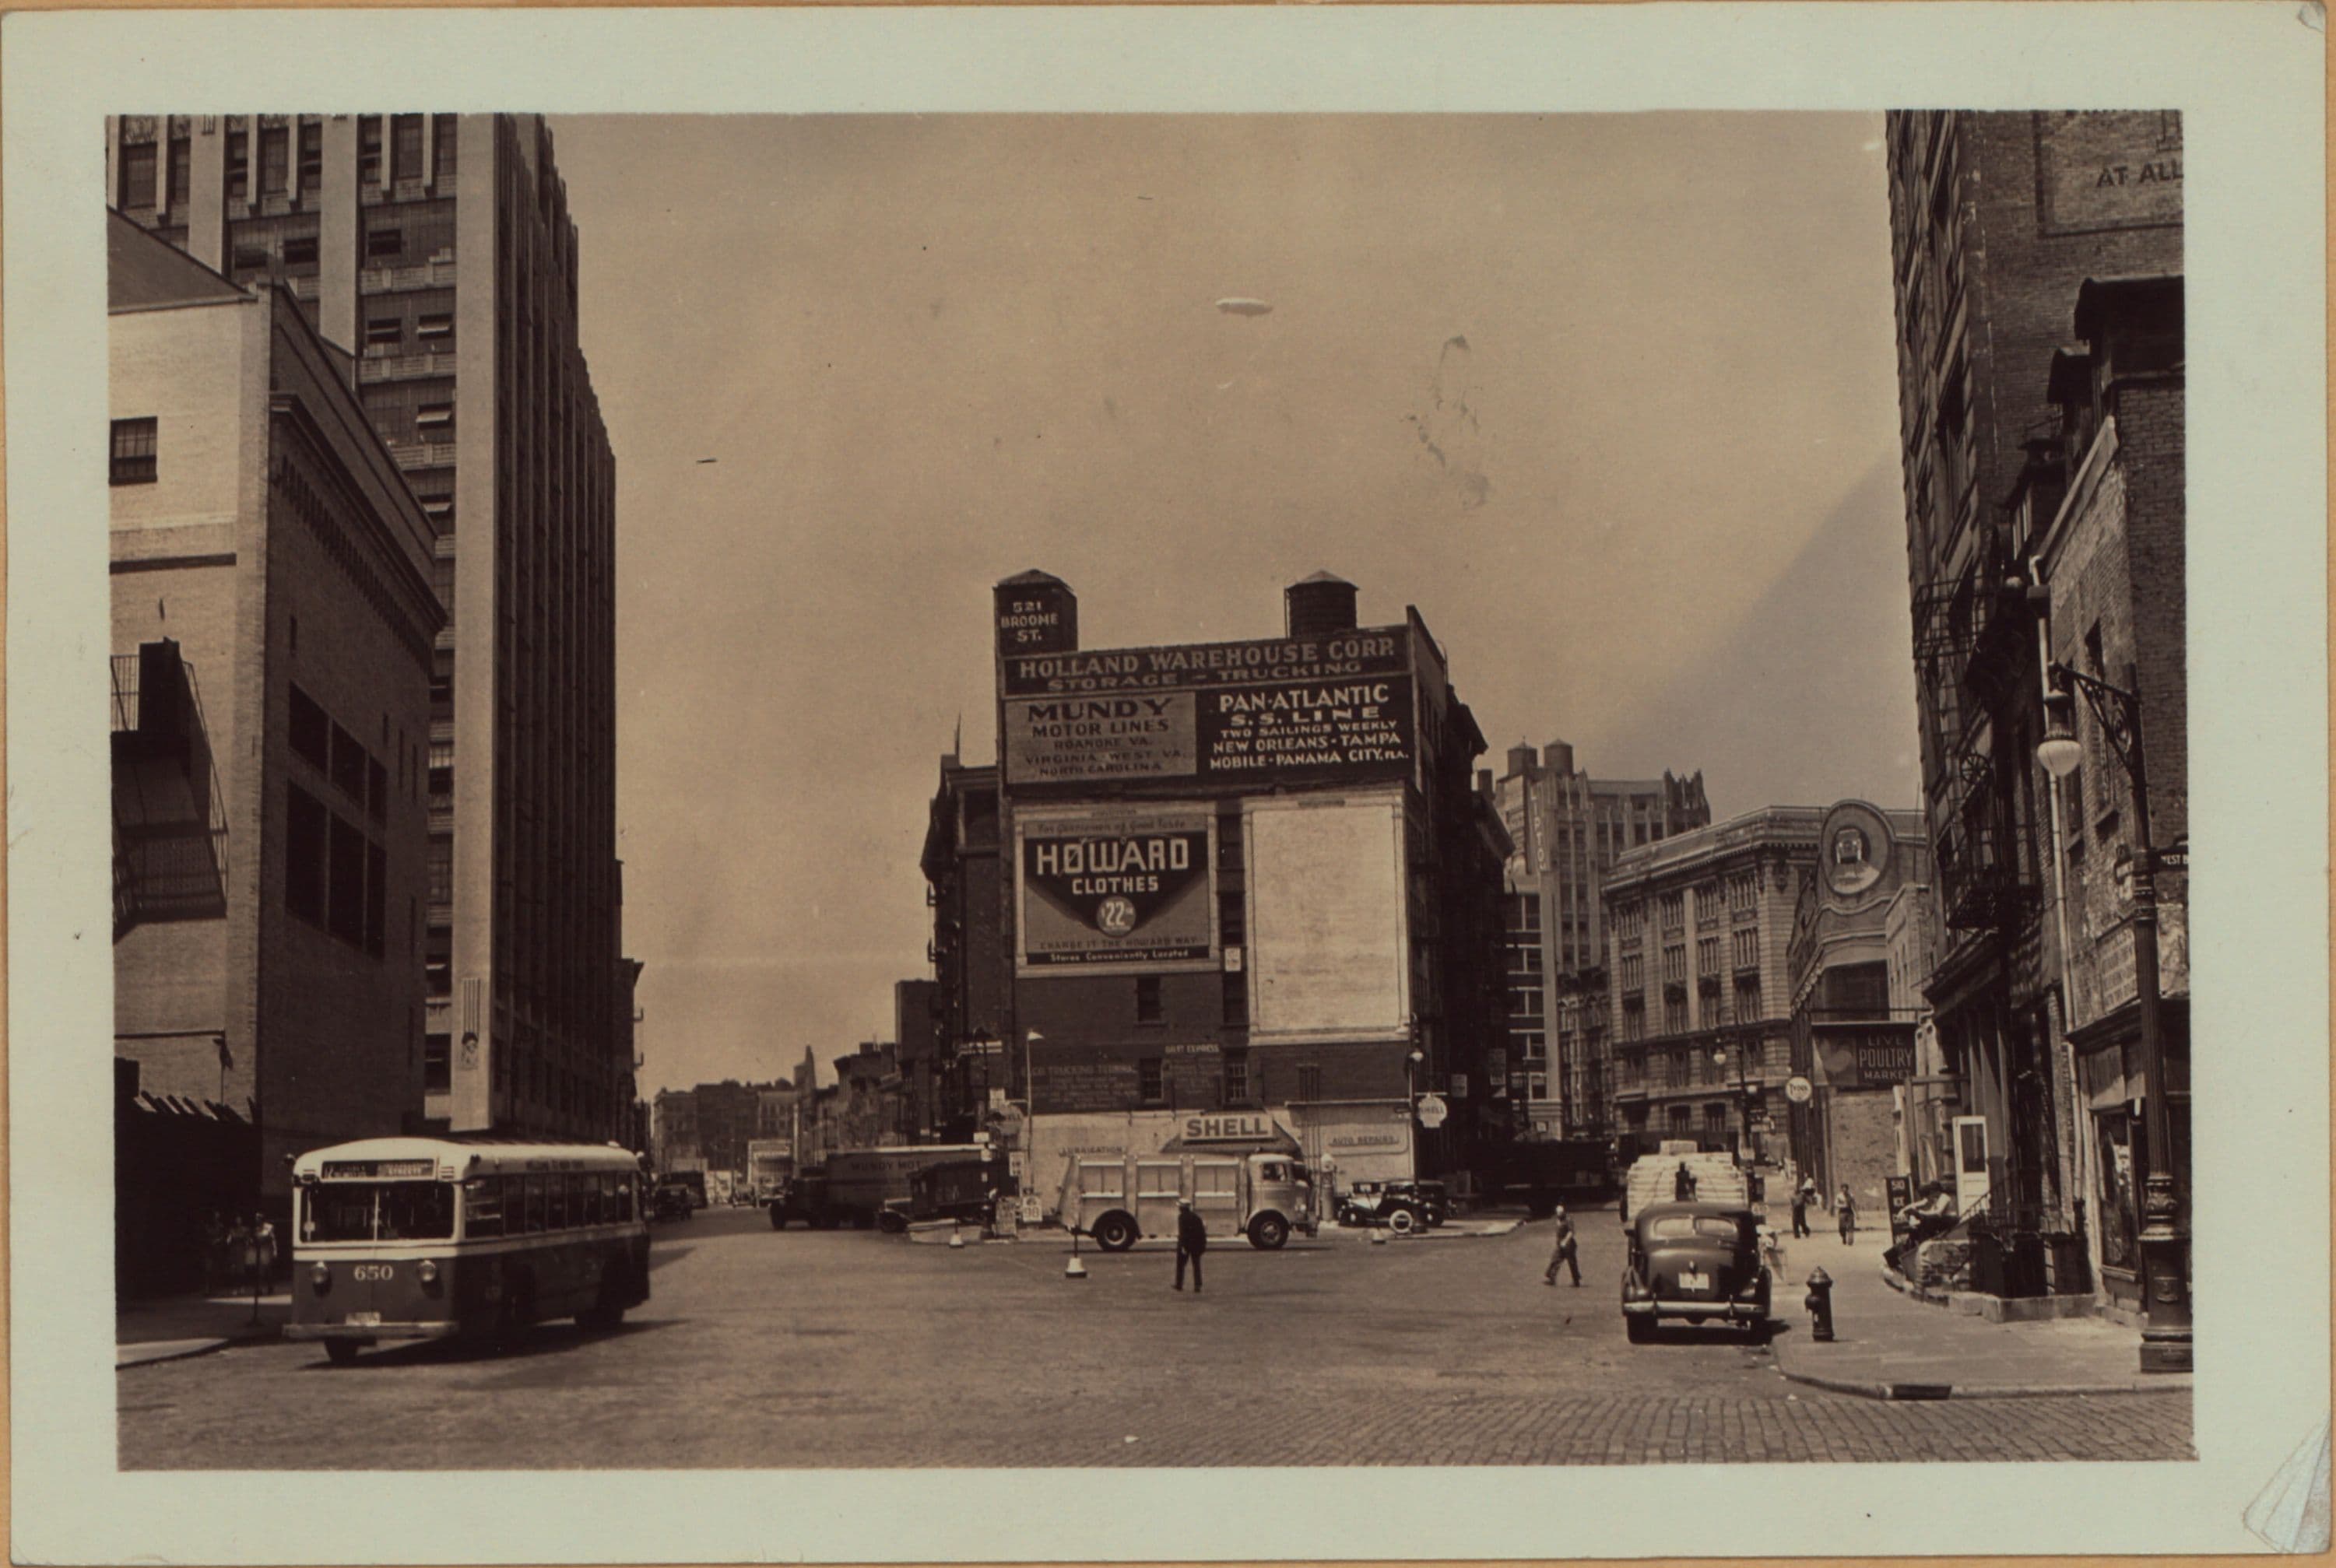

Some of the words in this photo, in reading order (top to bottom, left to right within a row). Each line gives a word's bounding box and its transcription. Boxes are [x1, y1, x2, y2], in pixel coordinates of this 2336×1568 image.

[2097, 167, 2128, 188] AT
[1013, 602, 1042, 612] 521
[1001, 613, 1059, 628] BROOME
[1017, 629, 1043, 642] ST.
[1020, 654, 1139, 679] HOLLAND
[1150, 642, 1318, 671] WAREHOUSE
[1328, 638, 1395, 658] CORP.
[1047, 673, 1178, 691] STORAGE
[1217, 661, 1361, 681] TRUCKING
[1027, 699, 1172, 721] MUNDY
[1292, 707, 1380, 723] LINE
[1032, 723, 1101, 738] MOTOR
[1110, 719, 1169, 734] LINES
[1221, 727, 1252, 738] TWO
[1259, 724, 1332, 737] SAILINGS
[1337, 720, 1396, 731] WEEKLY
[1054, 738, 1122, 750] ROANOKE
[1213, 740, 1249, 754] NEW
[1109, 750, 1153, 760] WEST
[1088, 762, 1162, 775] CAROLINA
[1036, 838, 1189, 875] HOWARD
[1071, 875, 1159, 895] CLOTHES
[1101, 938, 1120, 948] THE
[1126, 936, 1171, 946] HOWARD
[1175, 935, 1197, 945] WAY
[1085, 951, 1148, 960] Conveniently
[1152, 949, 1189, 959] Located
[1867, 1035, 1905, 1047] LIVE
[1859, 1047, 1913, 1068] POULTRY
[1864, 1069, 1911, 1080] MARKET
[1419, 1106, 1445, 1115] SHELL
[1186, 1117, 1269, 1138] SHELL
[1332, 1136, 1354, 1146] AUTO
[354, 1265, 393, 1281] 650
